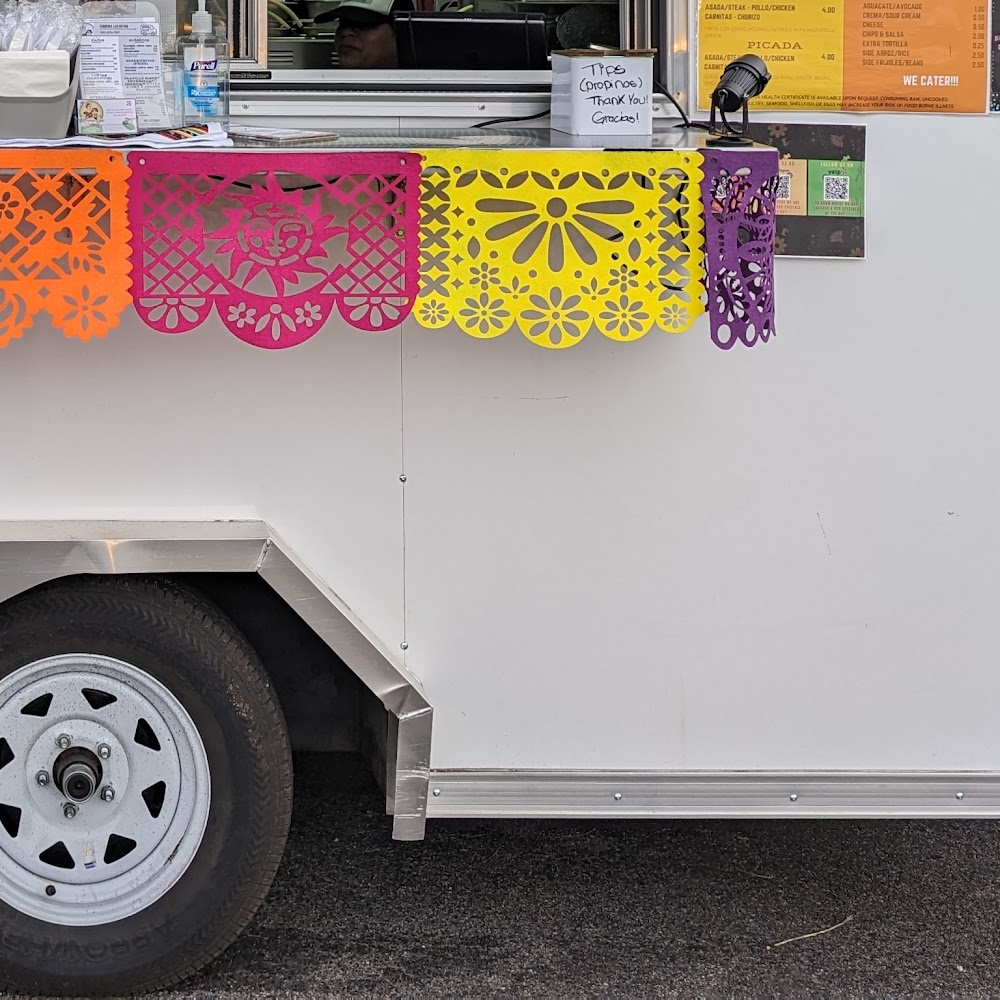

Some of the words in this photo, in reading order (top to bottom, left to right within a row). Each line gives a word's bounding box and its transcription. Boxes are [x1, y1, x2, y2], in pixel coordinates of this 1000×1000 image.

[747, 41, 803, 49] PICADA
[580, 77, 643, 92] (propinas)
[903, 75, 918, 86] WE
[921, 75, 958, 86] CATER!!!
[592, 111, 640, 125] Gracias!
